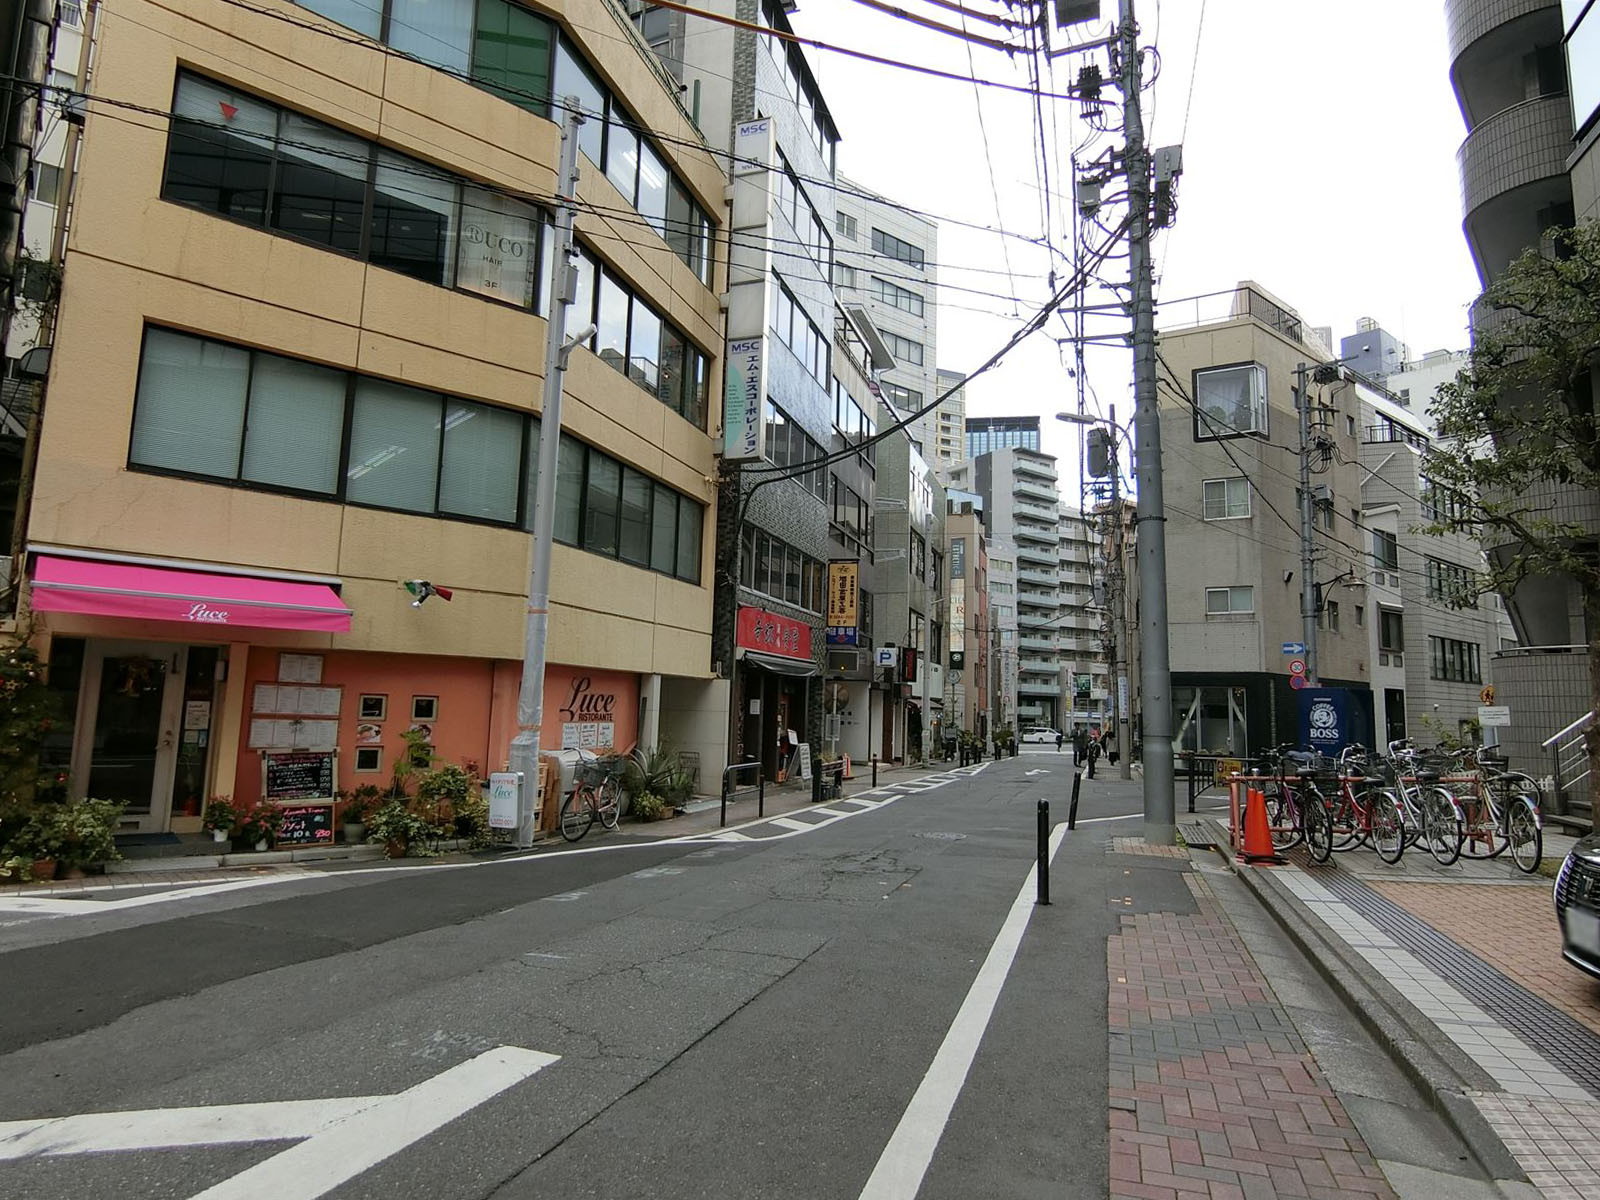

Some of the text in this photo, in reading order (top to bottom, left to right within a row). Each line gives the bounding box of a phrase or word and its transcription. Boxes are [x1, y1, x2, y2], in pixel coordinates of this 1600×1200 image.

[741, 122, 767, 136] MSC
[482, 256, 503, 266] HAIR
[484, 279, 499, 289] 3F
[731, 341, 760, 353] MSC
[744, 355, 760, 455] エム・エスコーポレーション
[181, 603, 229, 620] Luce
[880, 652, 892, 663] P
[559, 676, 616, 722] Luce
[1312, 703, 1334, 711] COFFEE
[578, 713, 614, 722] RISTORANTE
[1310, 728, 1339, 739] BOSS
